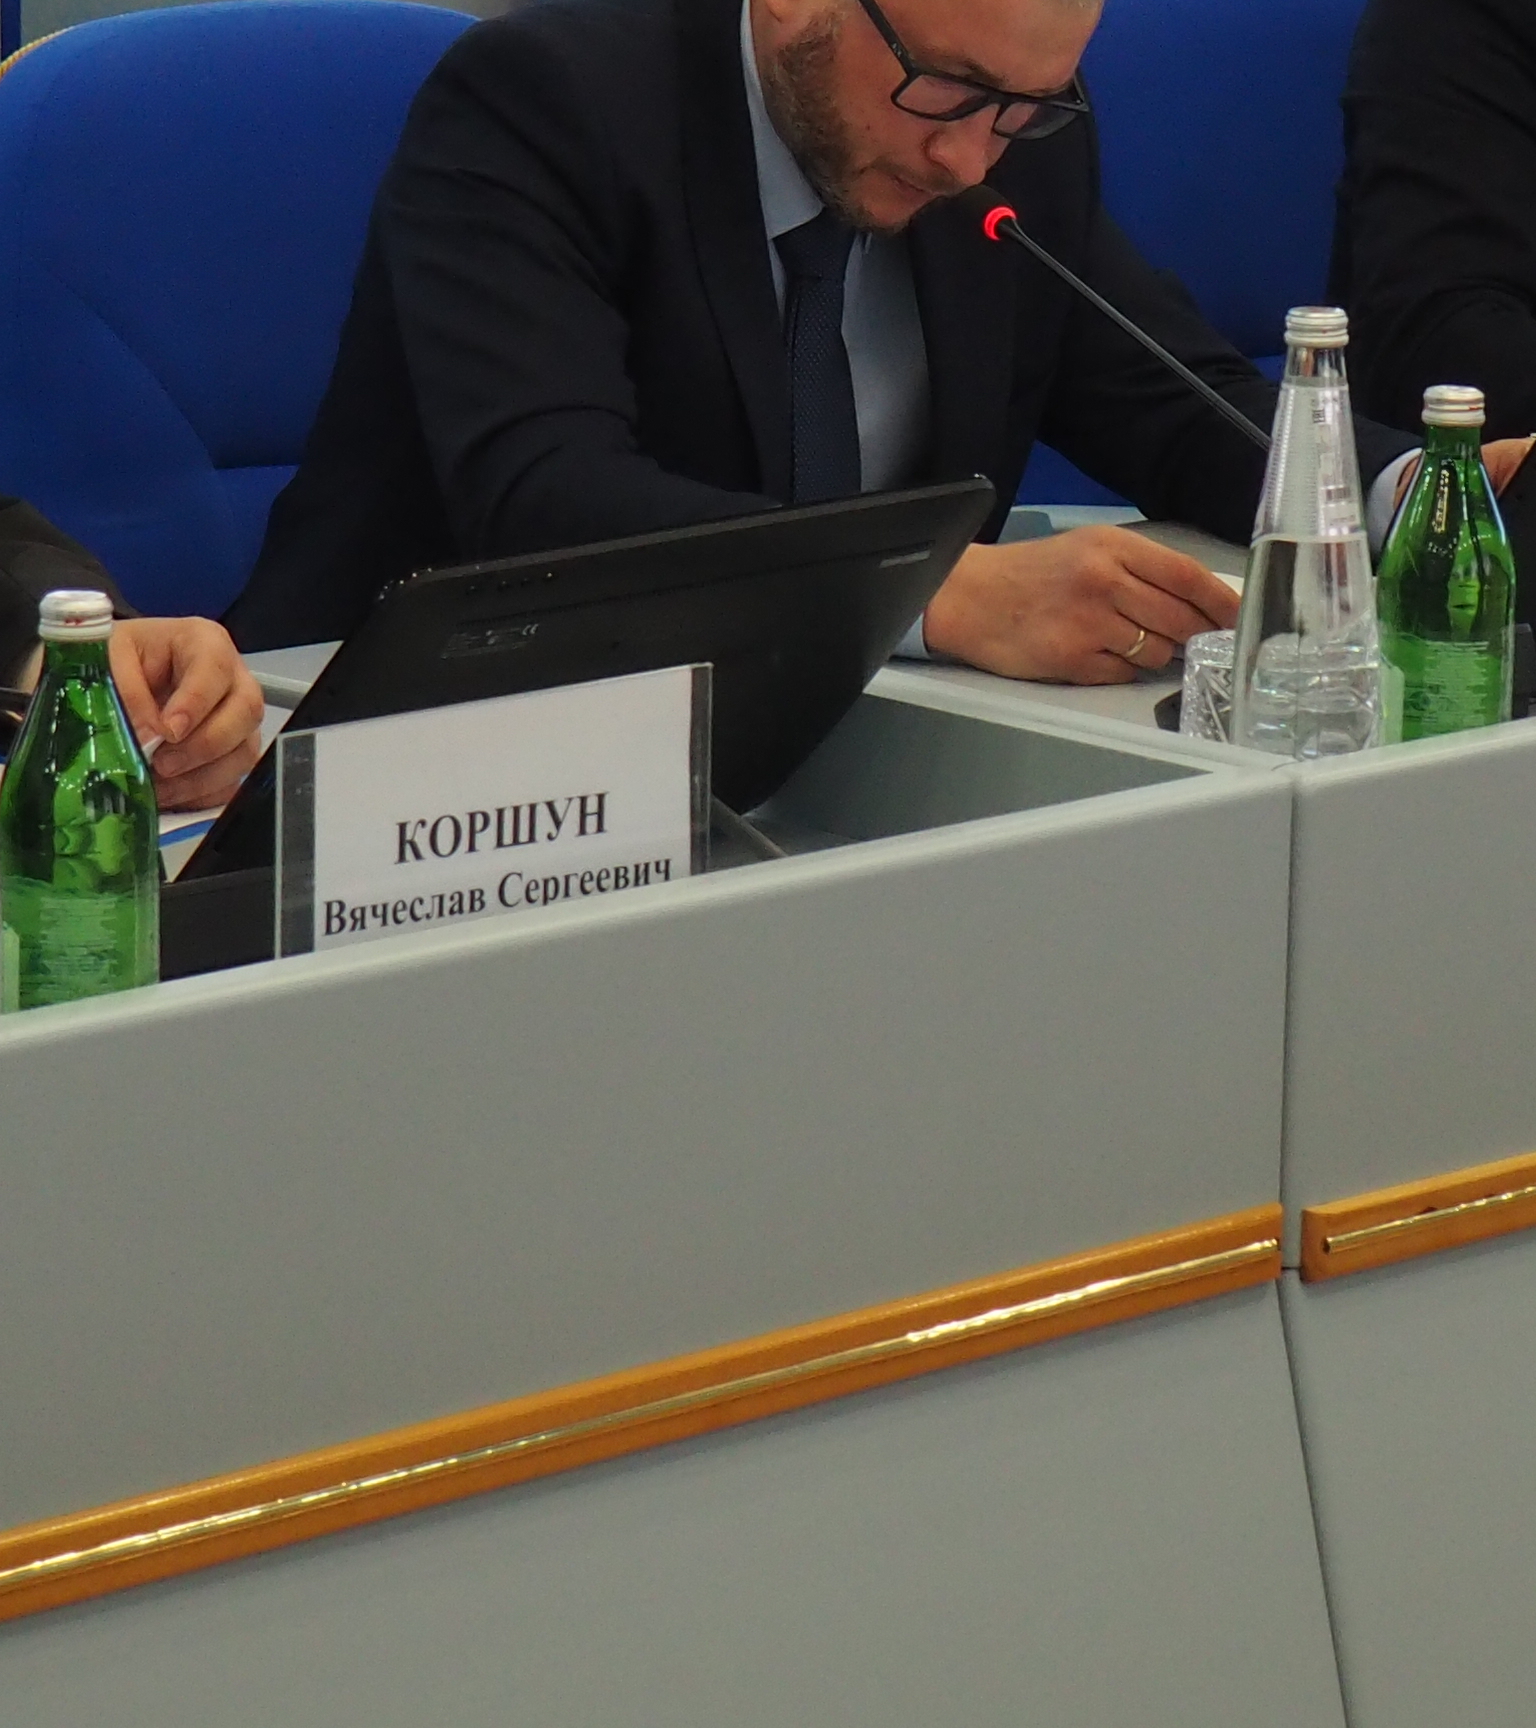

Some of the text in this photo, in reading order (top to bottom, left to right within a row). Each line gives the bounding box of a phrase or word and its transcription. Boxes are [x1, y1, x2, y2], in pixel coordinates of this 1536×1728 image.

[393, 791, 610, 865] КОРШУН
[323, 858, 673, 937] Вячеслав Сергеевич
